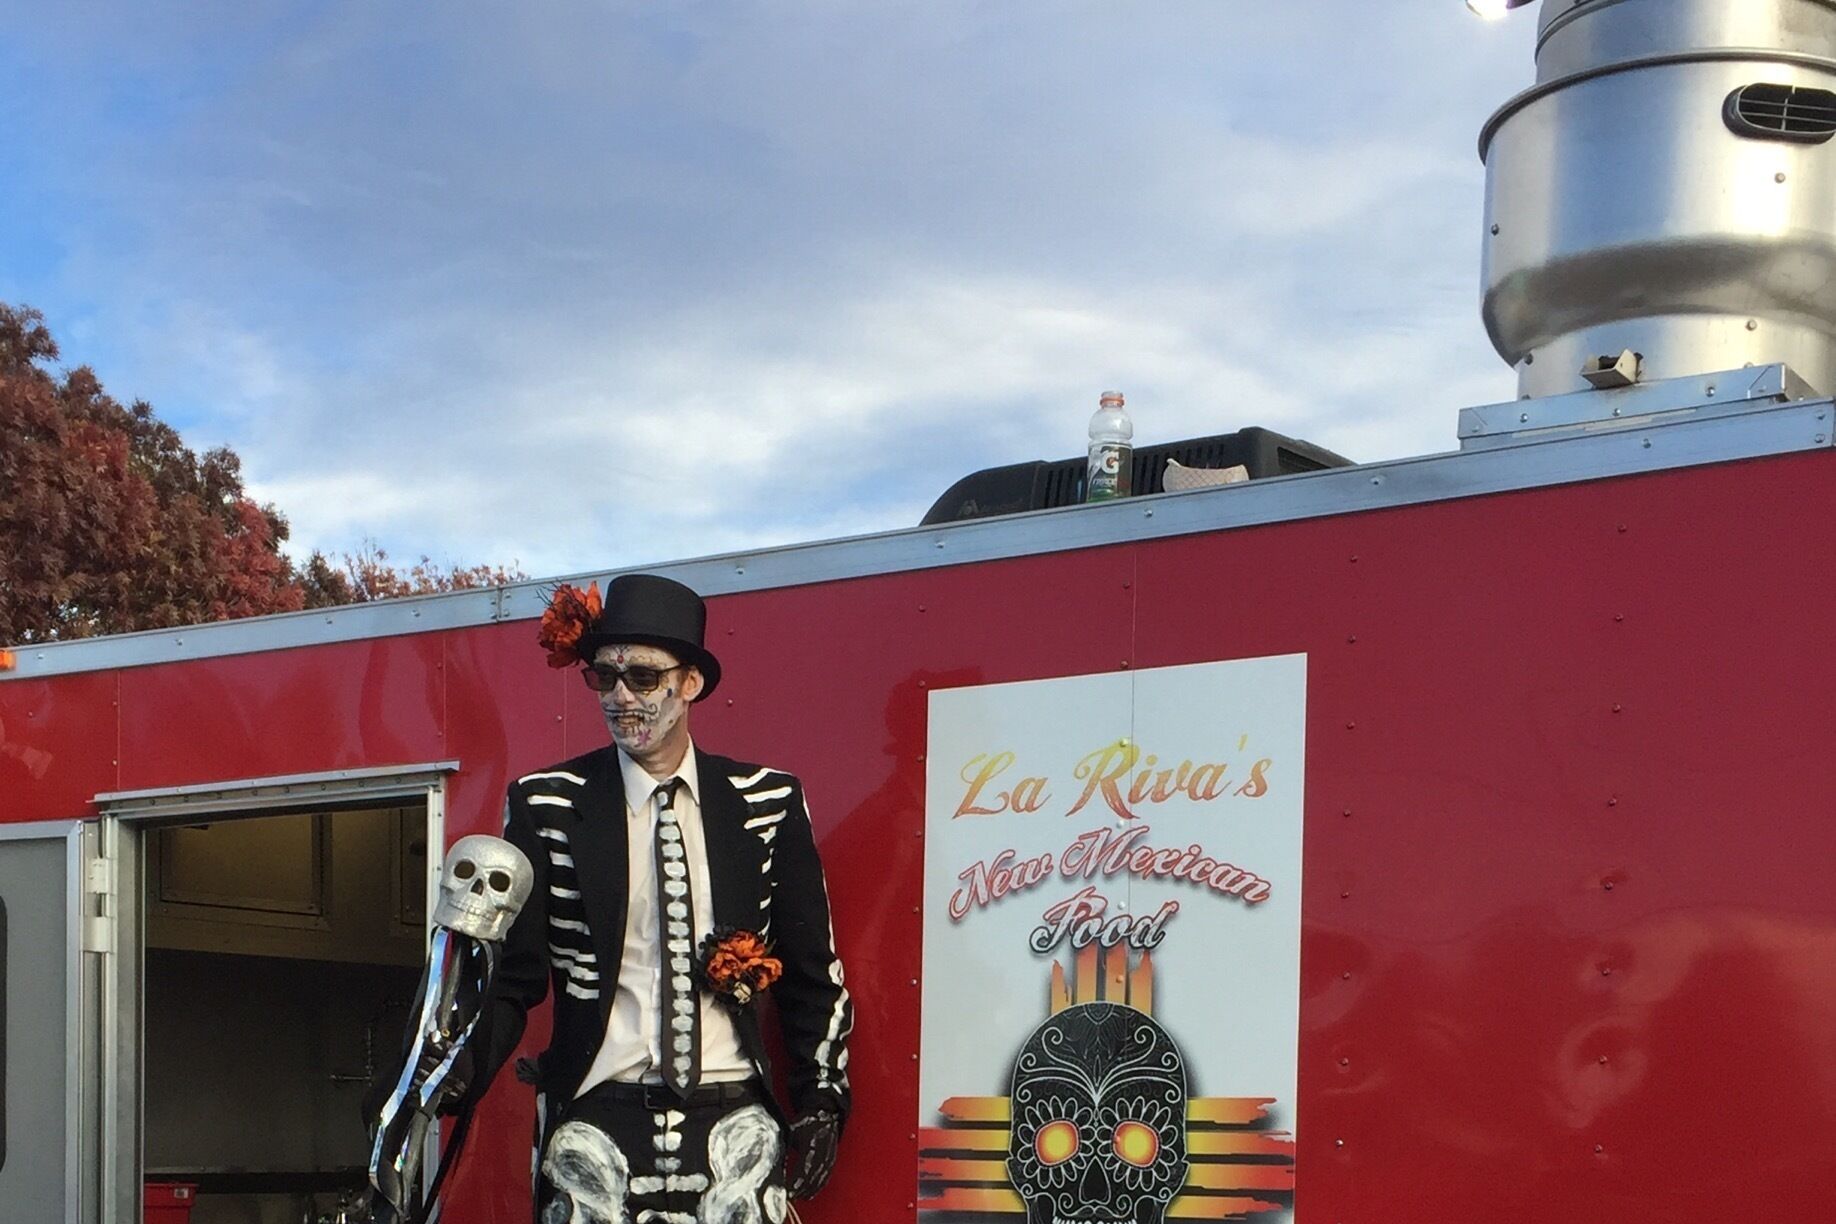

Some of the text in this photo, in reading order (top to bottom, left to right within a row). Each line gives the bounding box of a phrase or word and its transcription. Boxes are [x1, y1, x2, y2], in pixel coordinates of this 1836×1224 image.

[952, 734, 1272, 820] La Riva's
[948, 825, 1272, 922] New Mexican
[1029, 886, 1180, 954] Food
